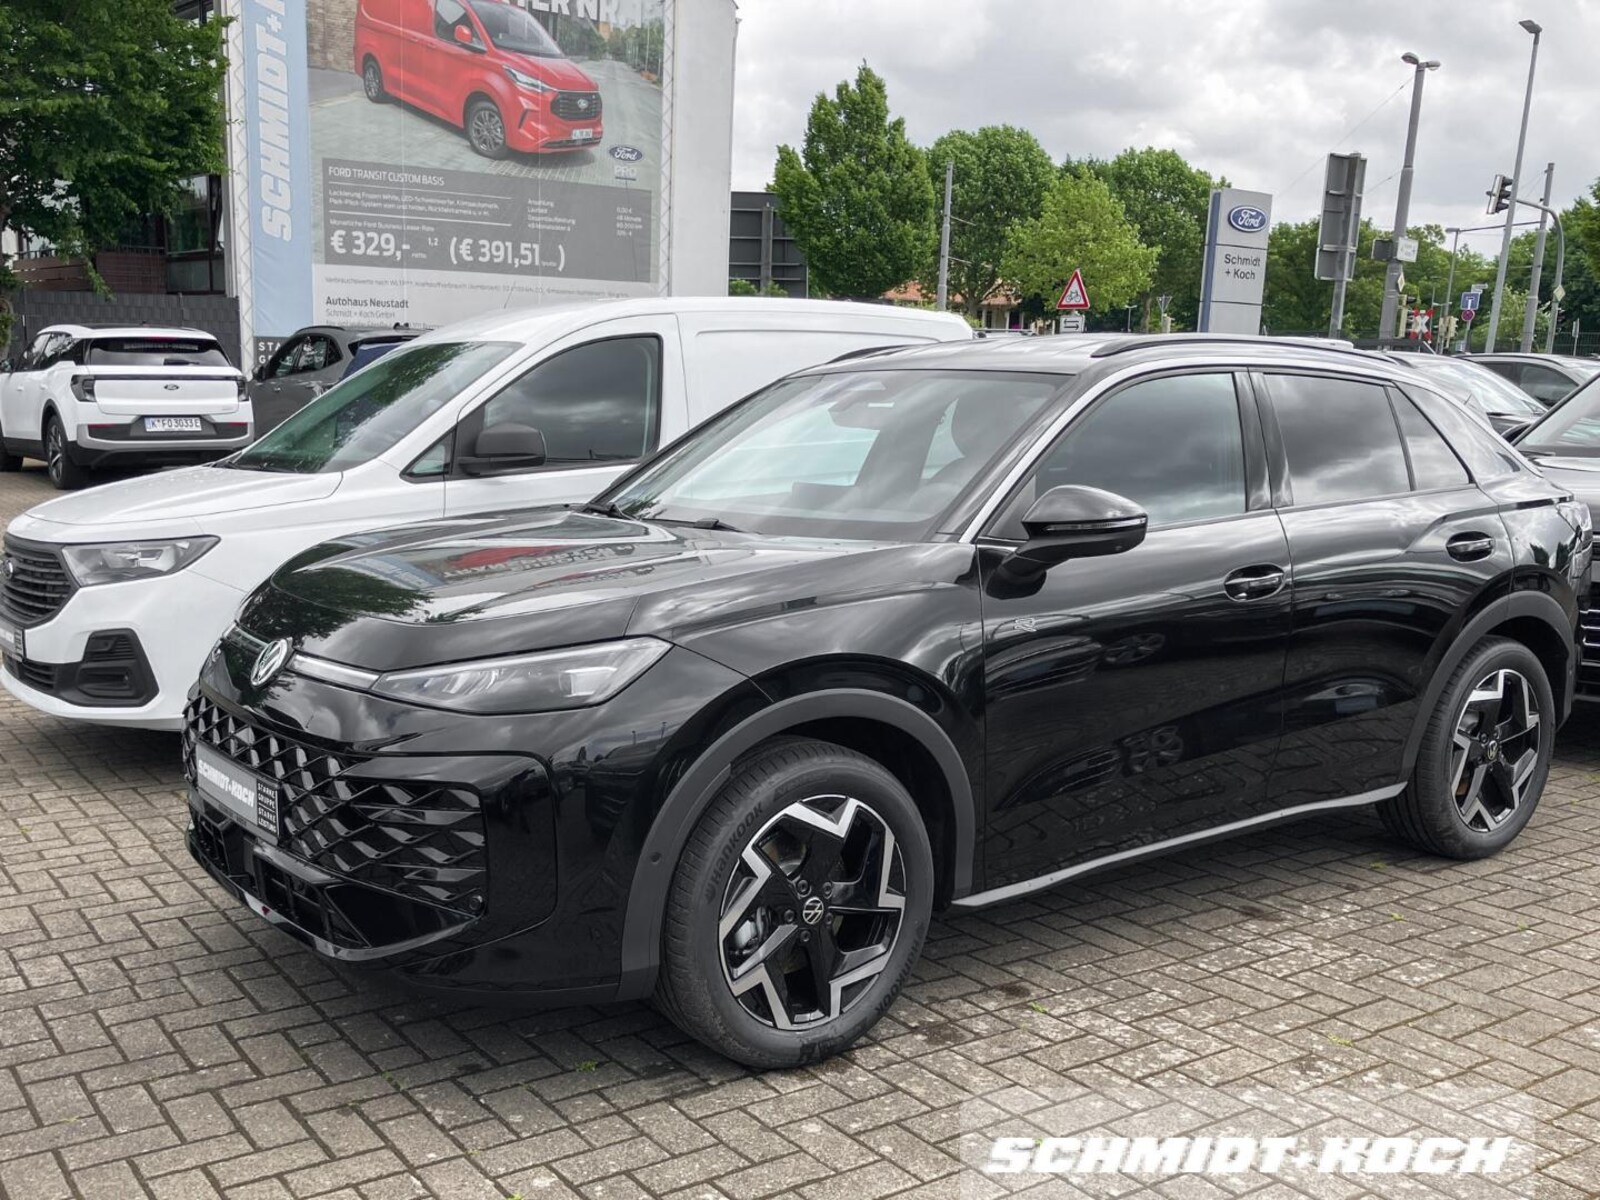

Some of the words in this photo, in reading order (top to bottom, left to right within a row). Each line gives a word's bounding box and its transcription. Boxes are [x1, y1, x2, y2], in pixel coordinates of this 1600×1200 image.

[328, 166, 351, 178] FORD
[352, 168, 387, 181] TRANSIT
[388, 171, 421, 184] CUSTOM
[422, 175, 445, 186] BASIS
[330, 229, 346, 254] €
[351, 230, 411, 261] 329,-
[478, 239, 540, 269] 391,51
[1224, 253, 1261, 267] Schmidt
[1233, 268, 1256, 280] Koch
[326, 295, 369, 307] Autohaus
[369, 298, 409, 309] Neustadt
